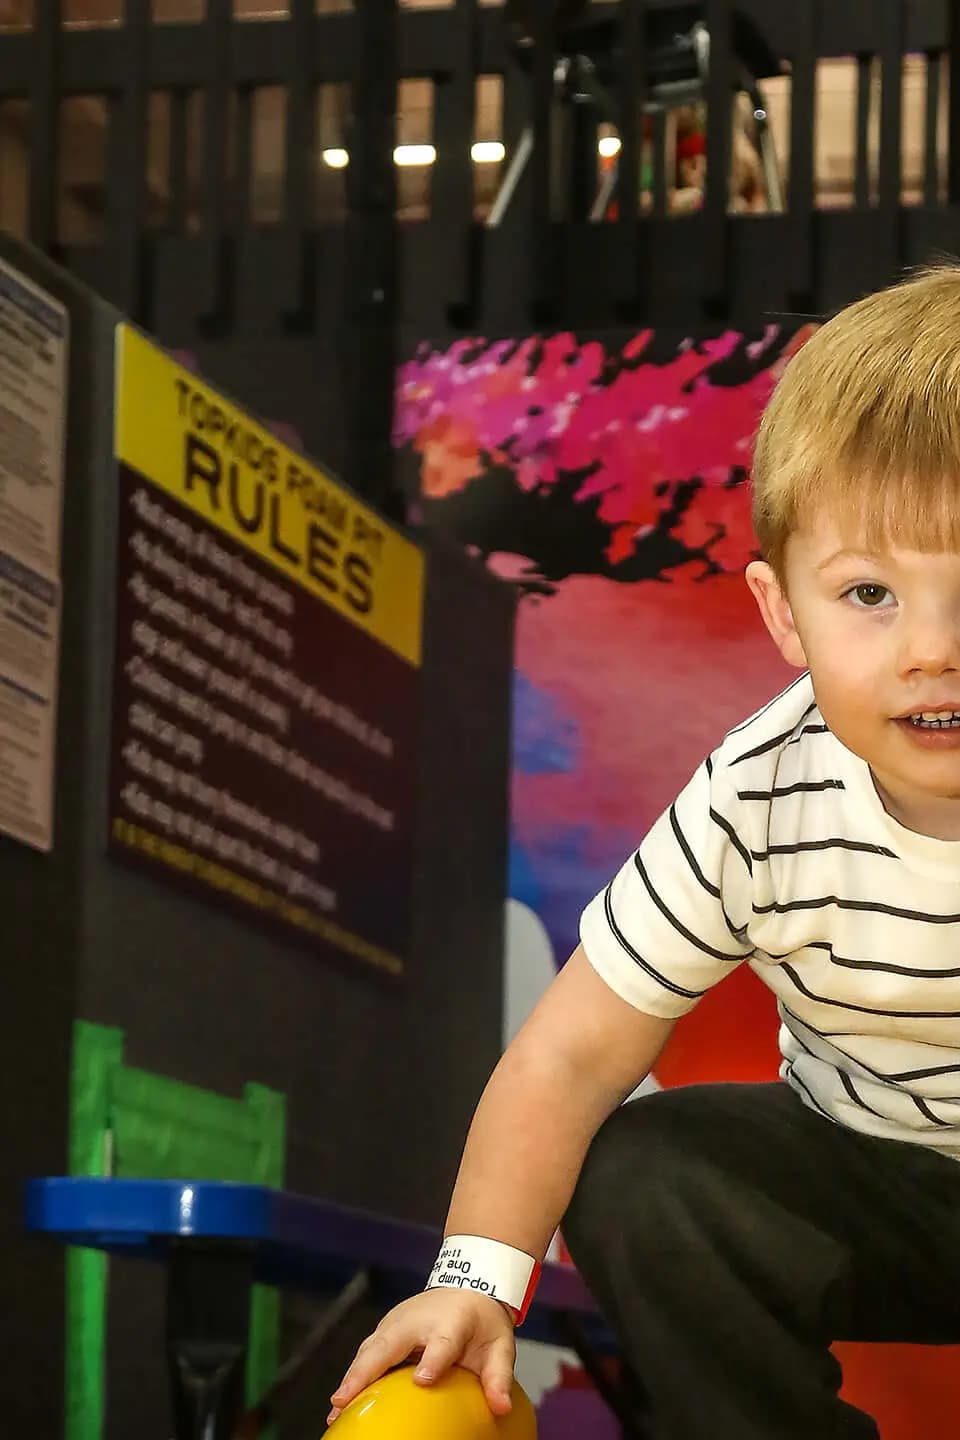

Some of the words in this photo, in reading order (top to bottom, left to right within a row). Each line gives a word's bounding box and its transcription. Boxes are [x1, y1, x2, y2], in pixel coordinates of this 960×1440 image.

[176, 378, 278, 483] TOPKIDS
[287, 462, 349, 531] FOAM
[186, 432, 373, 614] RULES
[438, 1272, 496, 1297] TopJump
[447, 1259, 471, 1274] One
